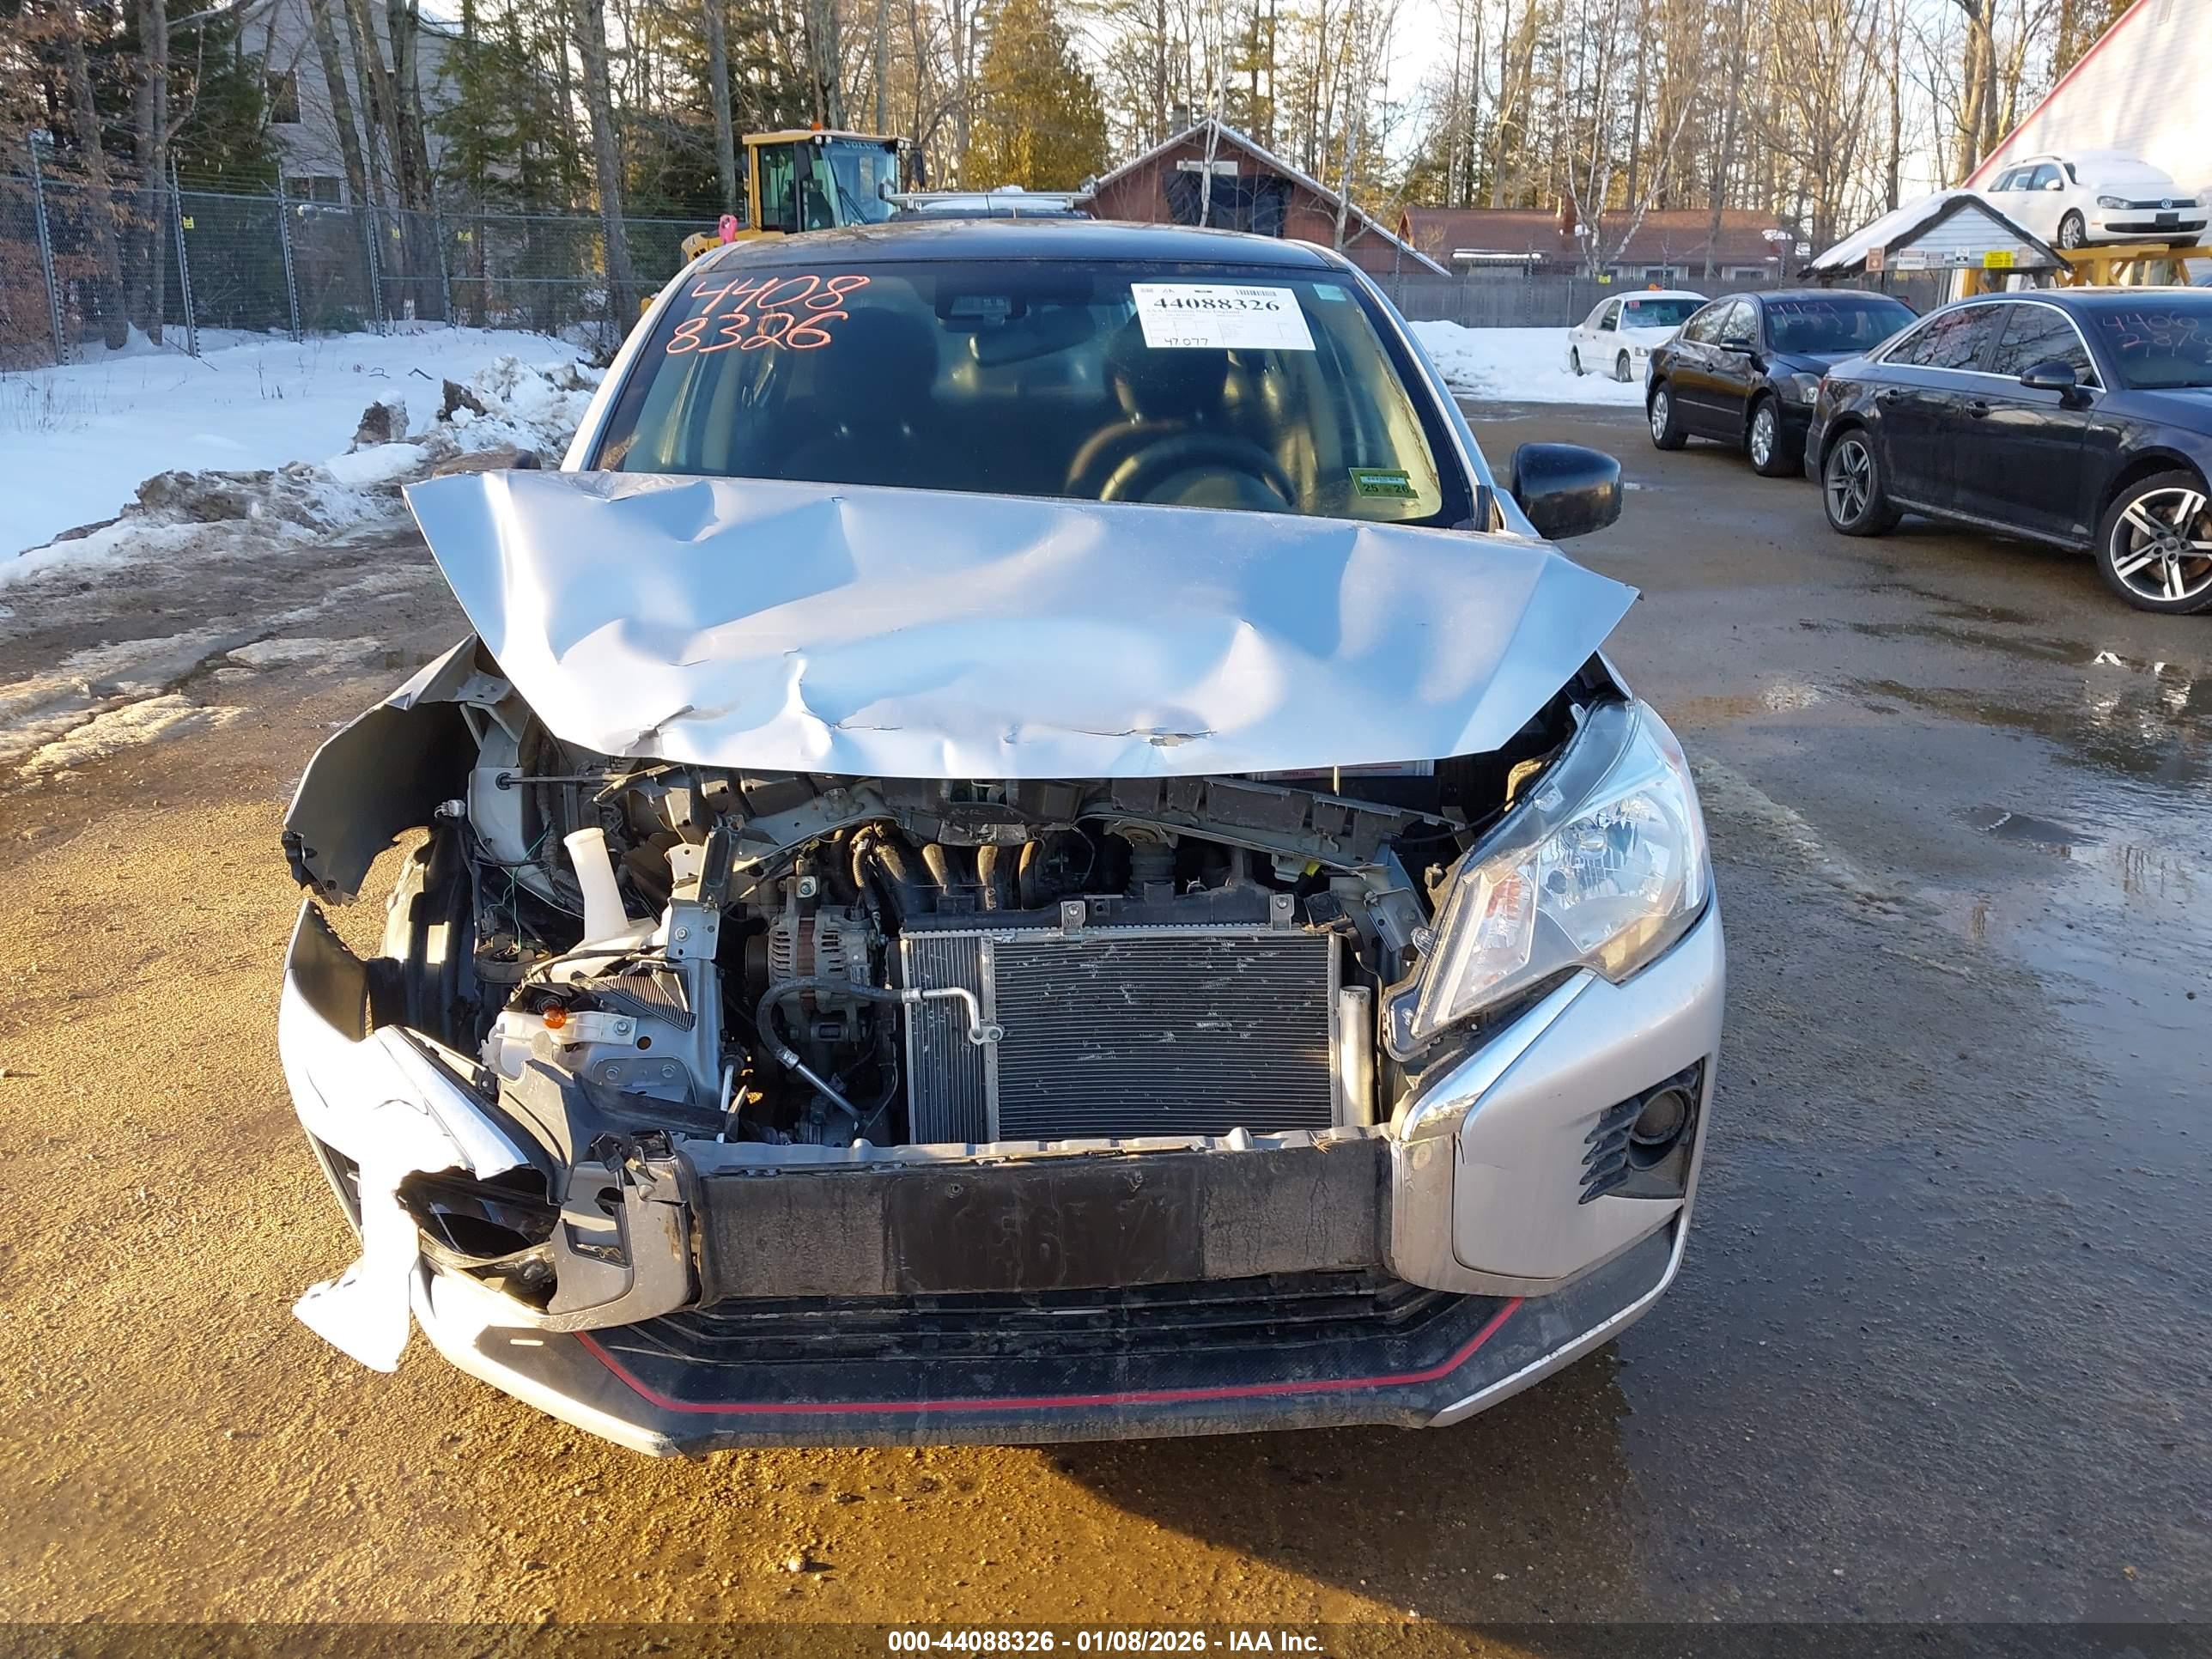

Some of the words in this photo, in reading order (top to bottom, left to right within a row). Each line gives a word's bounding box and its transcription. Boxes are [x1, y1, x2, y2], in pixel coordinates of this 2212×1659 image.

[844, 141, 878, 150] VOLVO
[690, 274, 872, 315] 4408
[1153, 297, 1280, 311] 44088326
[665, 311, 849, 354] 8326
[1363, 483, 1379, 492] 25
[1394, 484, 1410, 493] 26
